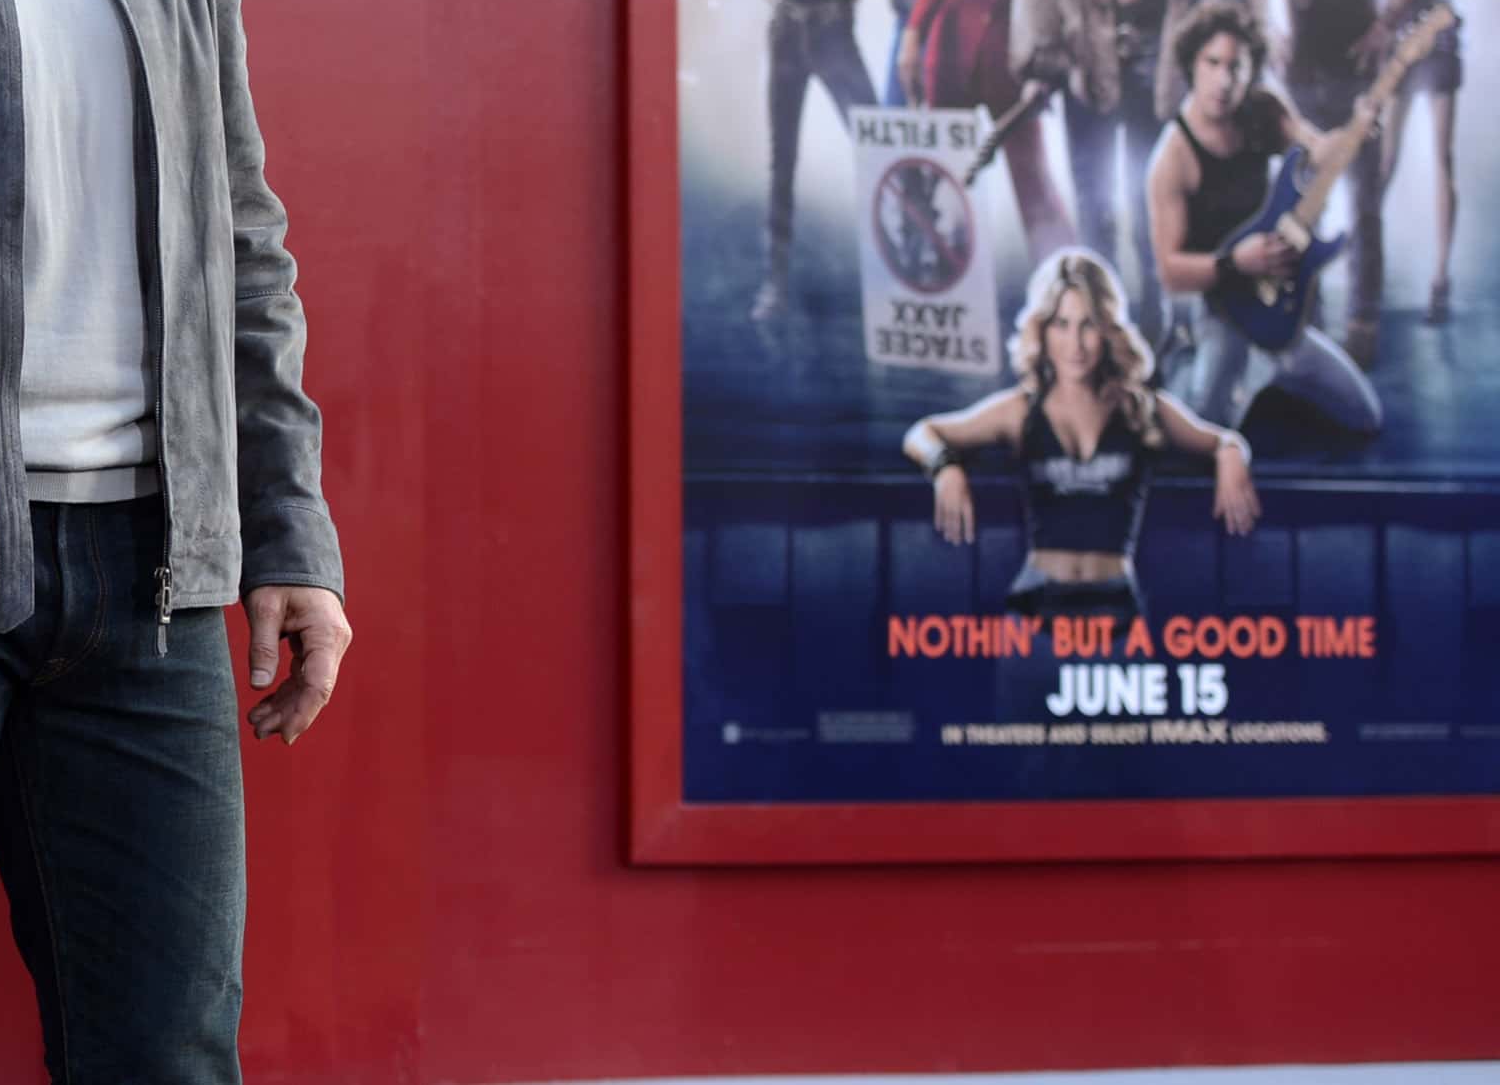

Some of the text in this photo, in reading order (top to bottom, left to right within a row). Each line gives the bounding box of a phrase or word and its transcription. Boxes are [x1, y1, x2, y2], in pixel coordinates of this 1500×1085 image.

[1052, 615, 1116, 657] BUT
[1124, 615, 1155, 657] A
[1163, 615, 1288, 658] GOOD
[1296, 615, 1377, 657] TIME
[1046, 664, 1229, 716] JUNE 15
